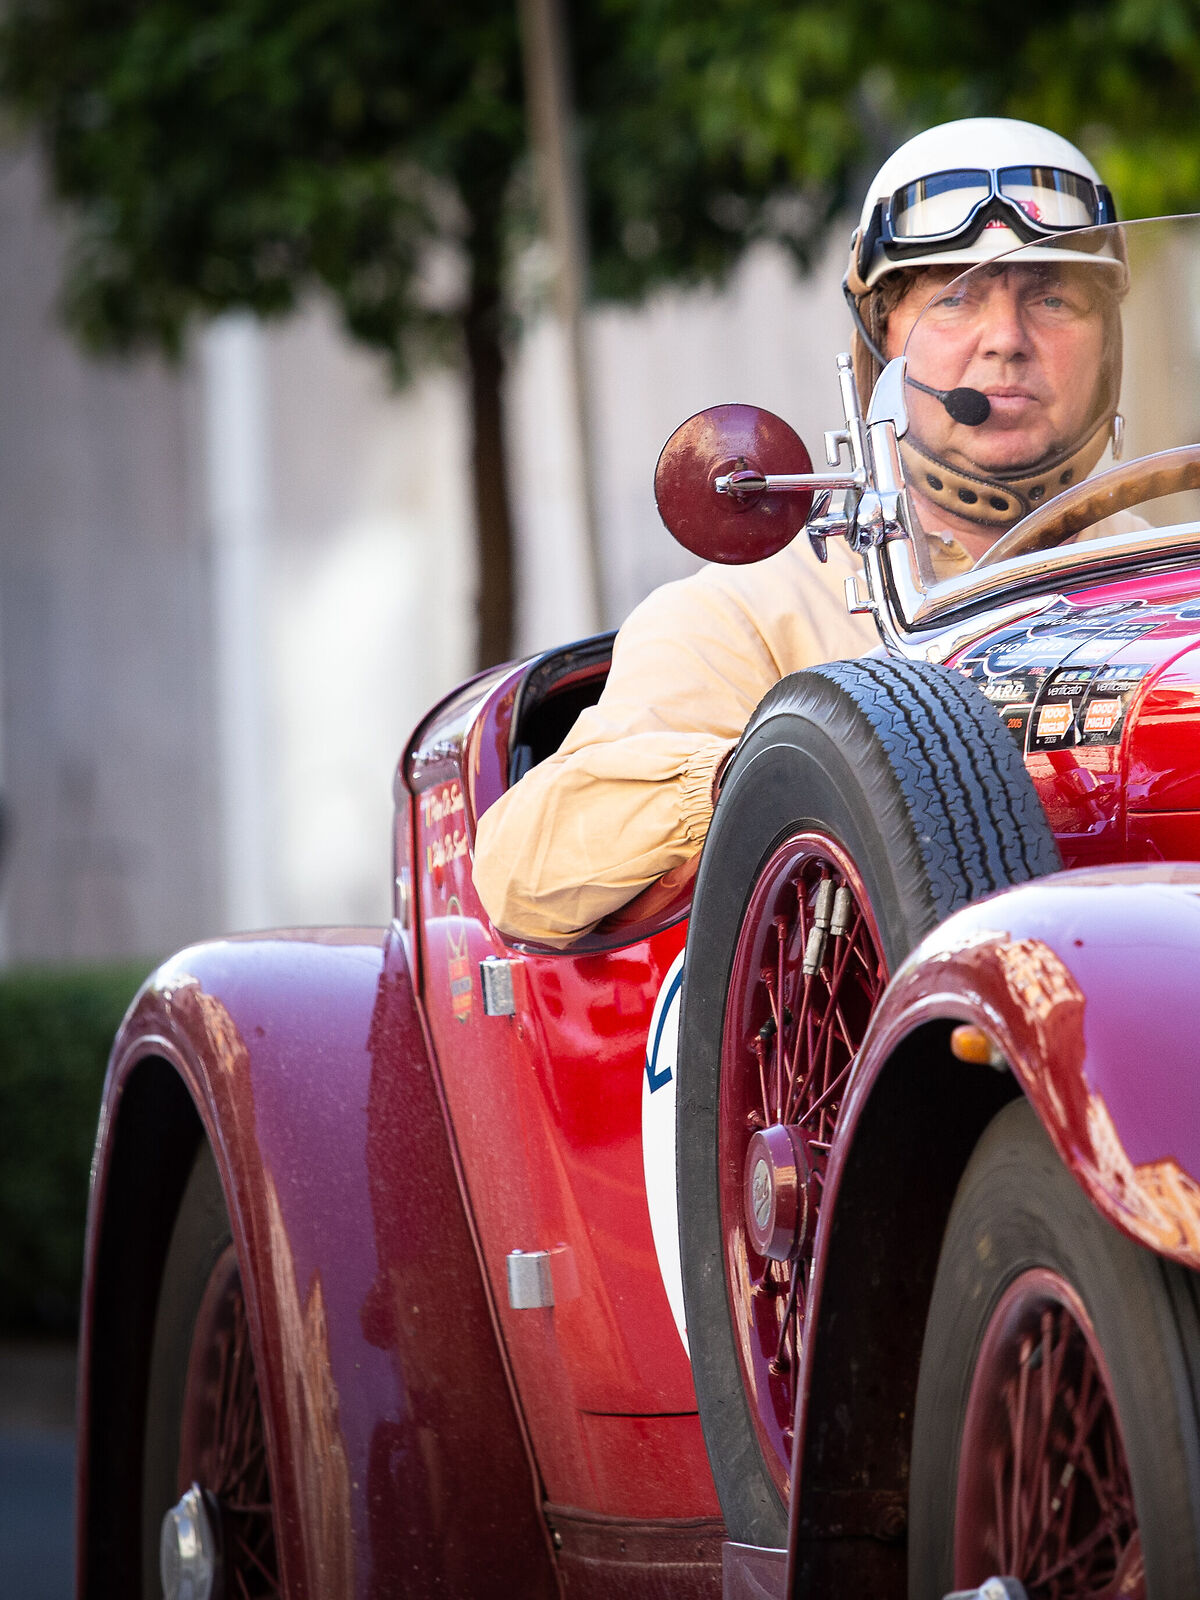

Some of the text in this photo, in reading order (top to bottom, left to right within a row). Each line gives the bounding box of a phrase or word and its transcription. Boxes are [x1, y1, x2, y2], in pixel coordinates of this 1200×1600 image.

[984, 642, 1065, 655] CHOPARD
[1047, 684, 1082, 697] verificato
[1097, 680, 1131, 692] verificato
[1044, 707, 1067, 719] 1000
[1091, 703, 1114, 714] 1000
[1006, 718, 1023, 729] 2005
[1039, 721, 1065, 732] MIGLIA
[1086, 717, 1112, 728] MIGLIA
